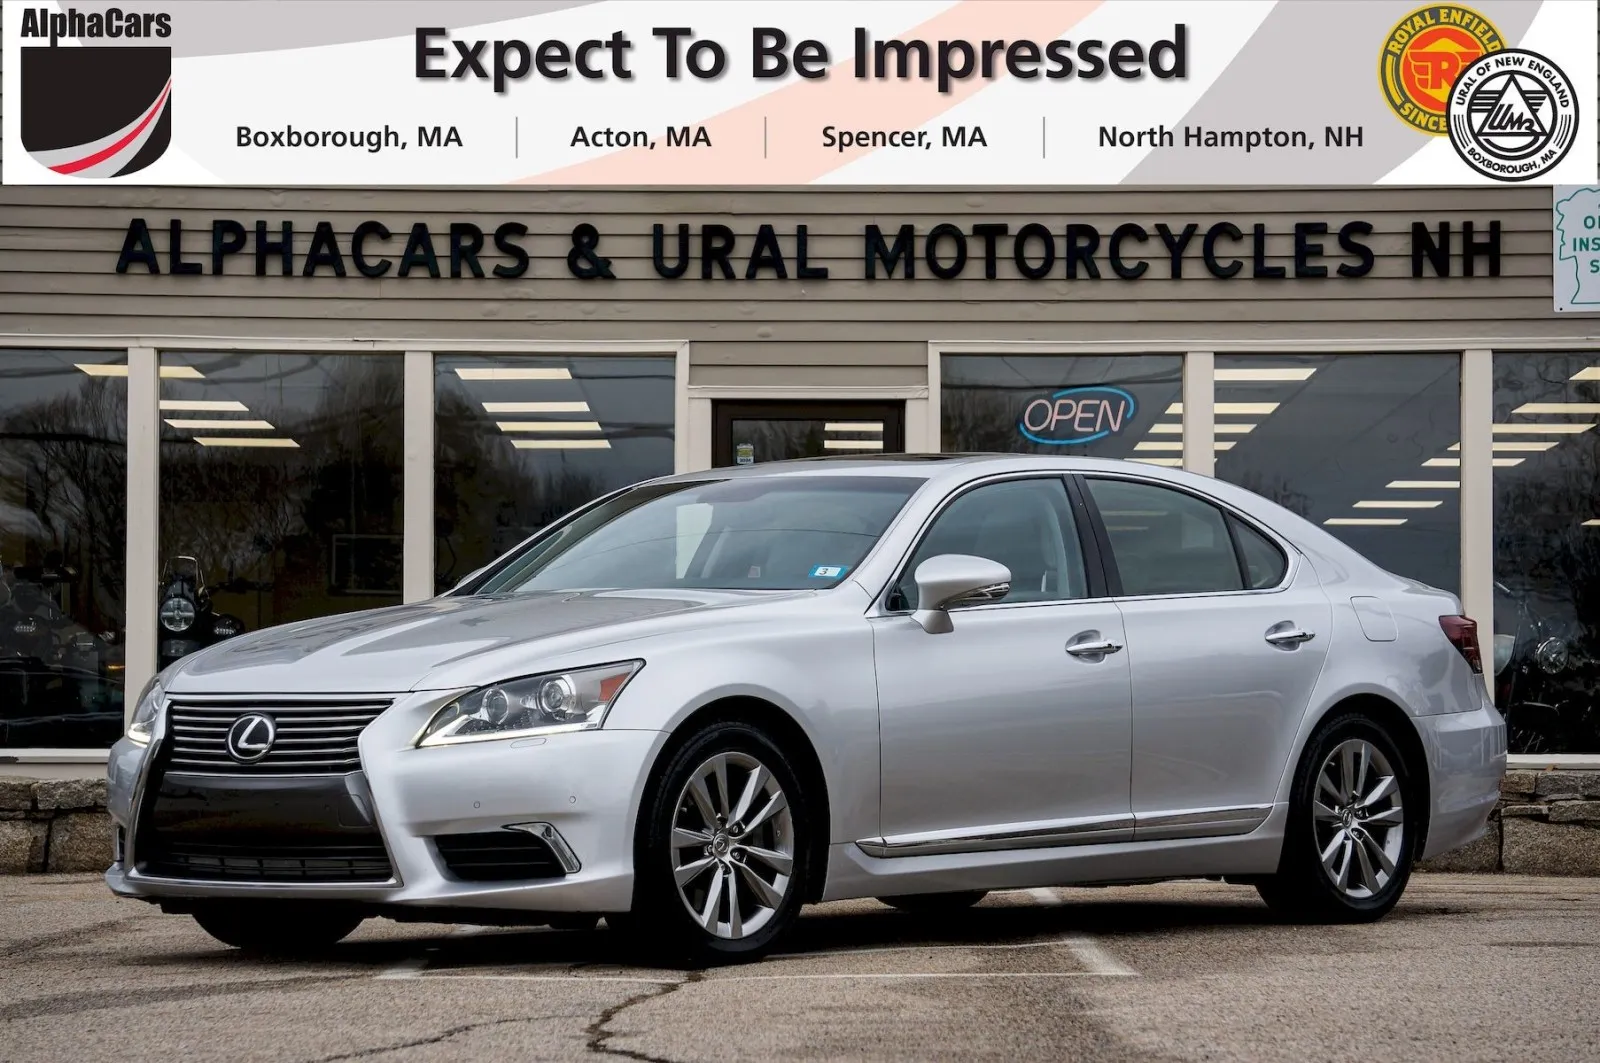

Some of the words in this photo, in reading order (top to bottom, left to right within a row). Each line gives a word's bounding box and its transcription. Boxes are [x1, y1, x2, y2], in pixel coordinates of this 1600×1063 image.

[116, 217, 530, 279] ALPHACARS
[567, 222, 617, 280] &
[653, 223, 829, 280] URAL
[864, 221, 1375, 280] MOTORCYCLES
[1411, 220, 1501, 278] NH
[1024, 399, 1126, 432] OPEN
